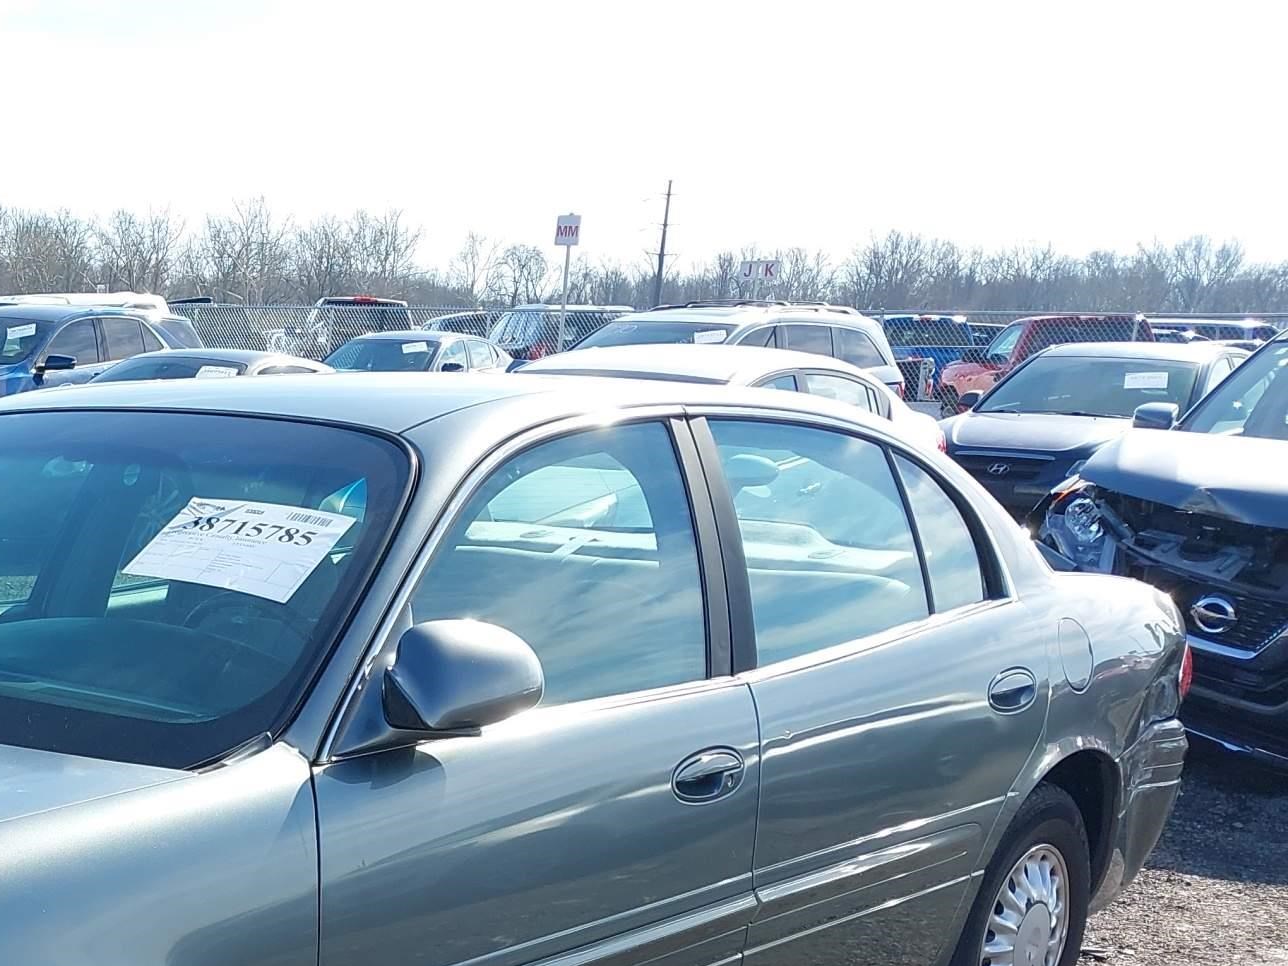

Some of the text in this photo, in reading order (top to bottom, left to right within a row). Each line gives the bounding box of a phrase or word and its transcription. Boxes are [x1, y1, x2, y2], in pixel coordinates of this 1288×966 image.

[556, 225, 579, 238] MM
[743, 263, 754, 278] J
[764, 263, 775, 277] K
[182, 516, 318, 547] 38715785
